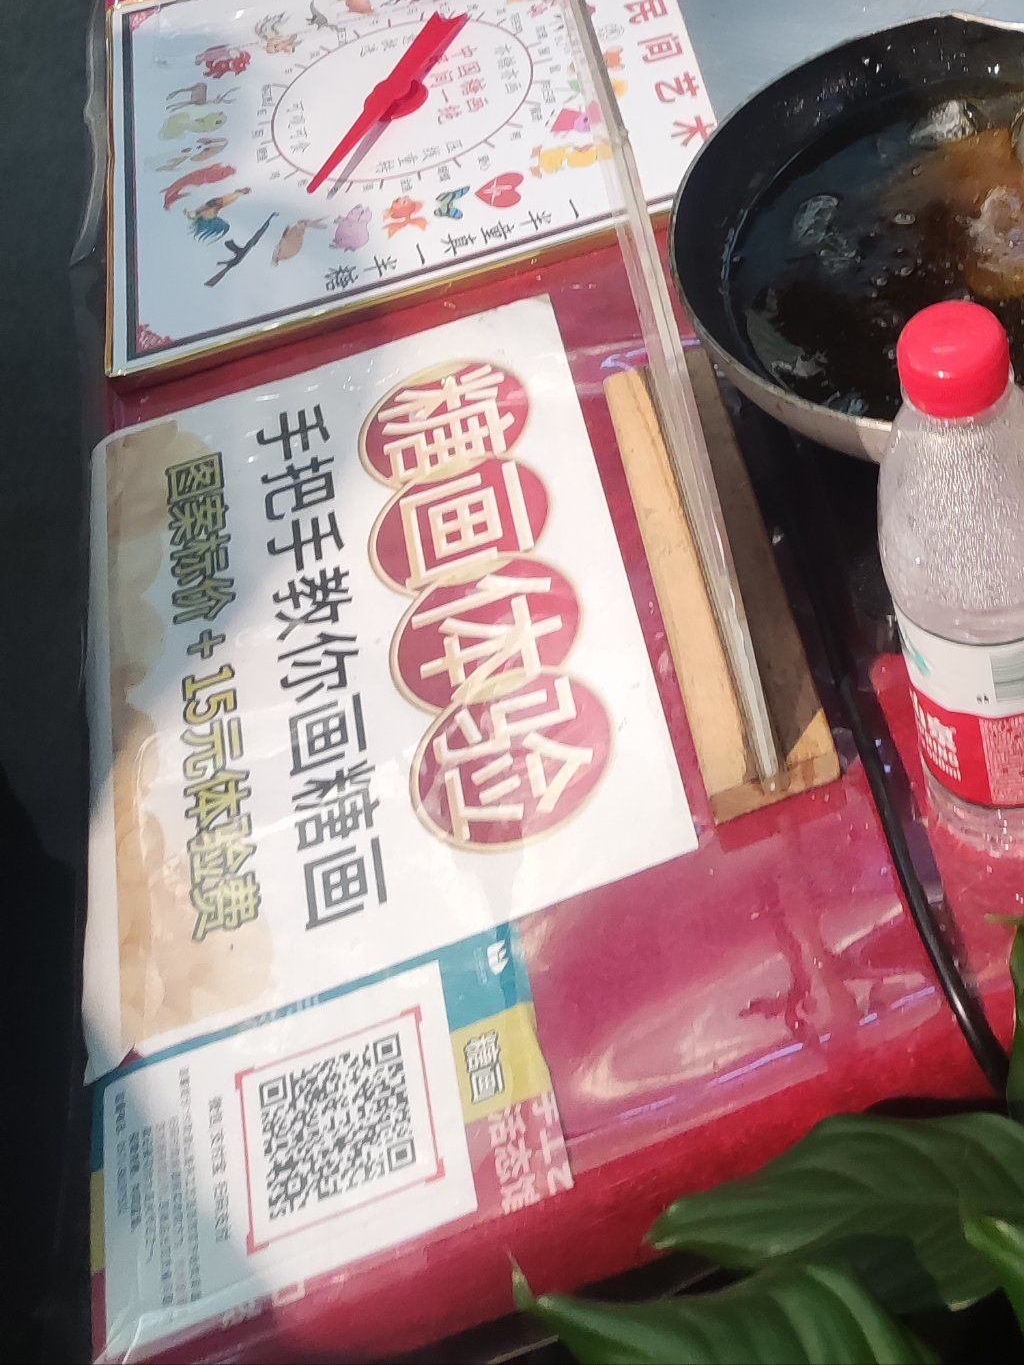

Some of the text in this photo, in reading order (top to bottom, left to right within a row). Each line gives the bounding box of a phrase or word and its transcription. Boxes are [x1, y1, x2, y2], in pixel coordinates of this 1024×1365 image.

[454, 41, 488, 114] 中国糖画
[325, 197, 580, 292] 一半童真一半糖
[164, 450, 236, 624] 图案标价
[377, 364, 592, 843] 糖画体验
[256, 403, 388, 931] 手把手教你画糖画
[464, 1029, 504, 1105] 糖画
